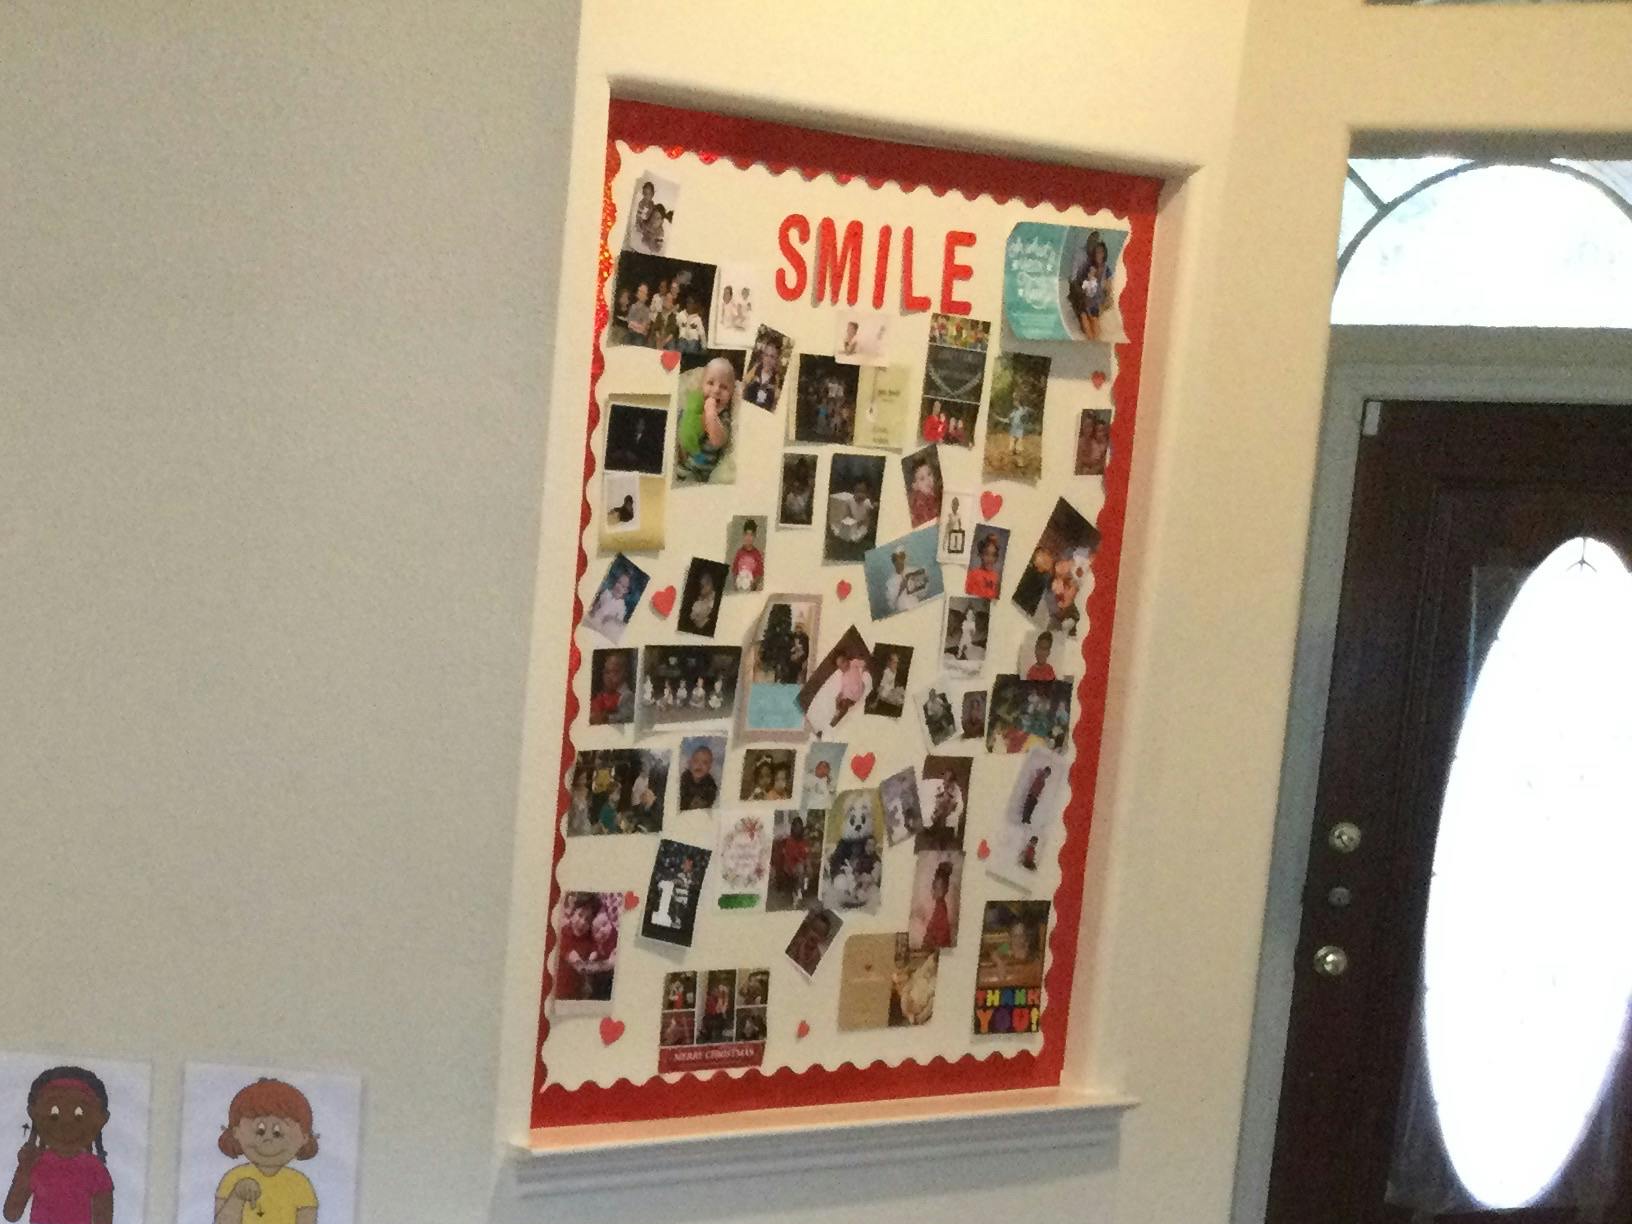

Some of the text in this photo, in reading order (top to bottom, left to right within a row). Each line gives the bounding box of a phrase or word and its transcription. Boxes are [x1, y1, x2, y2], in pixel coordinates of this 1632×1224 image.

[776, 214, 977, 315] SMILE
[975, 988, 1040, 1007] THANK
[975, 1007, 1040, 1033] YOU!
